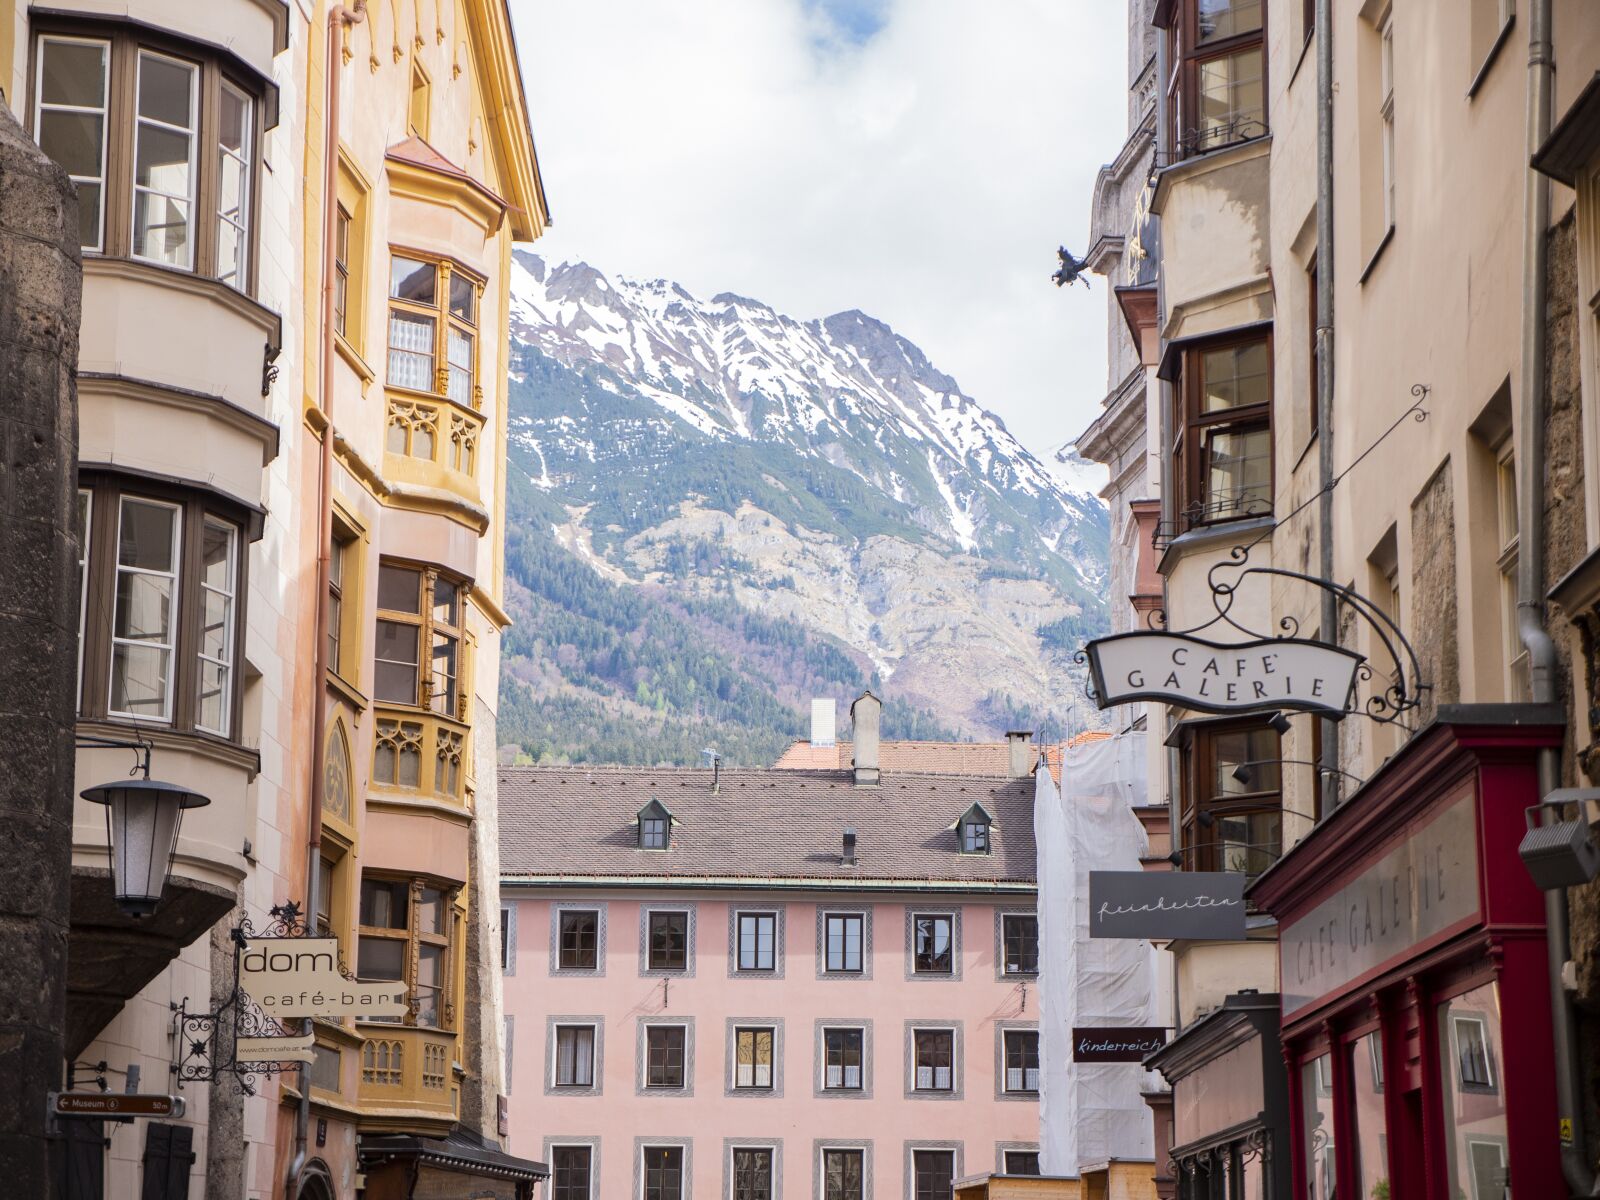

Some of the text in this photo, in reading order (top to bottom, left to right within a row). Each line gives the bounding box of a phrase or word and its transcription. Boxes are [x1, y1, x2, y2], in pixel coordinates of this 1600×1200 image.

[1127, 670, 1324, 701] GALERIE
[1098, 896, 1239, 923] feinheiten
[243, 947, 333, 972] dom
[263, 991, 389, 1006] café-bar
[72, 1099, 104, 1108] Museum
